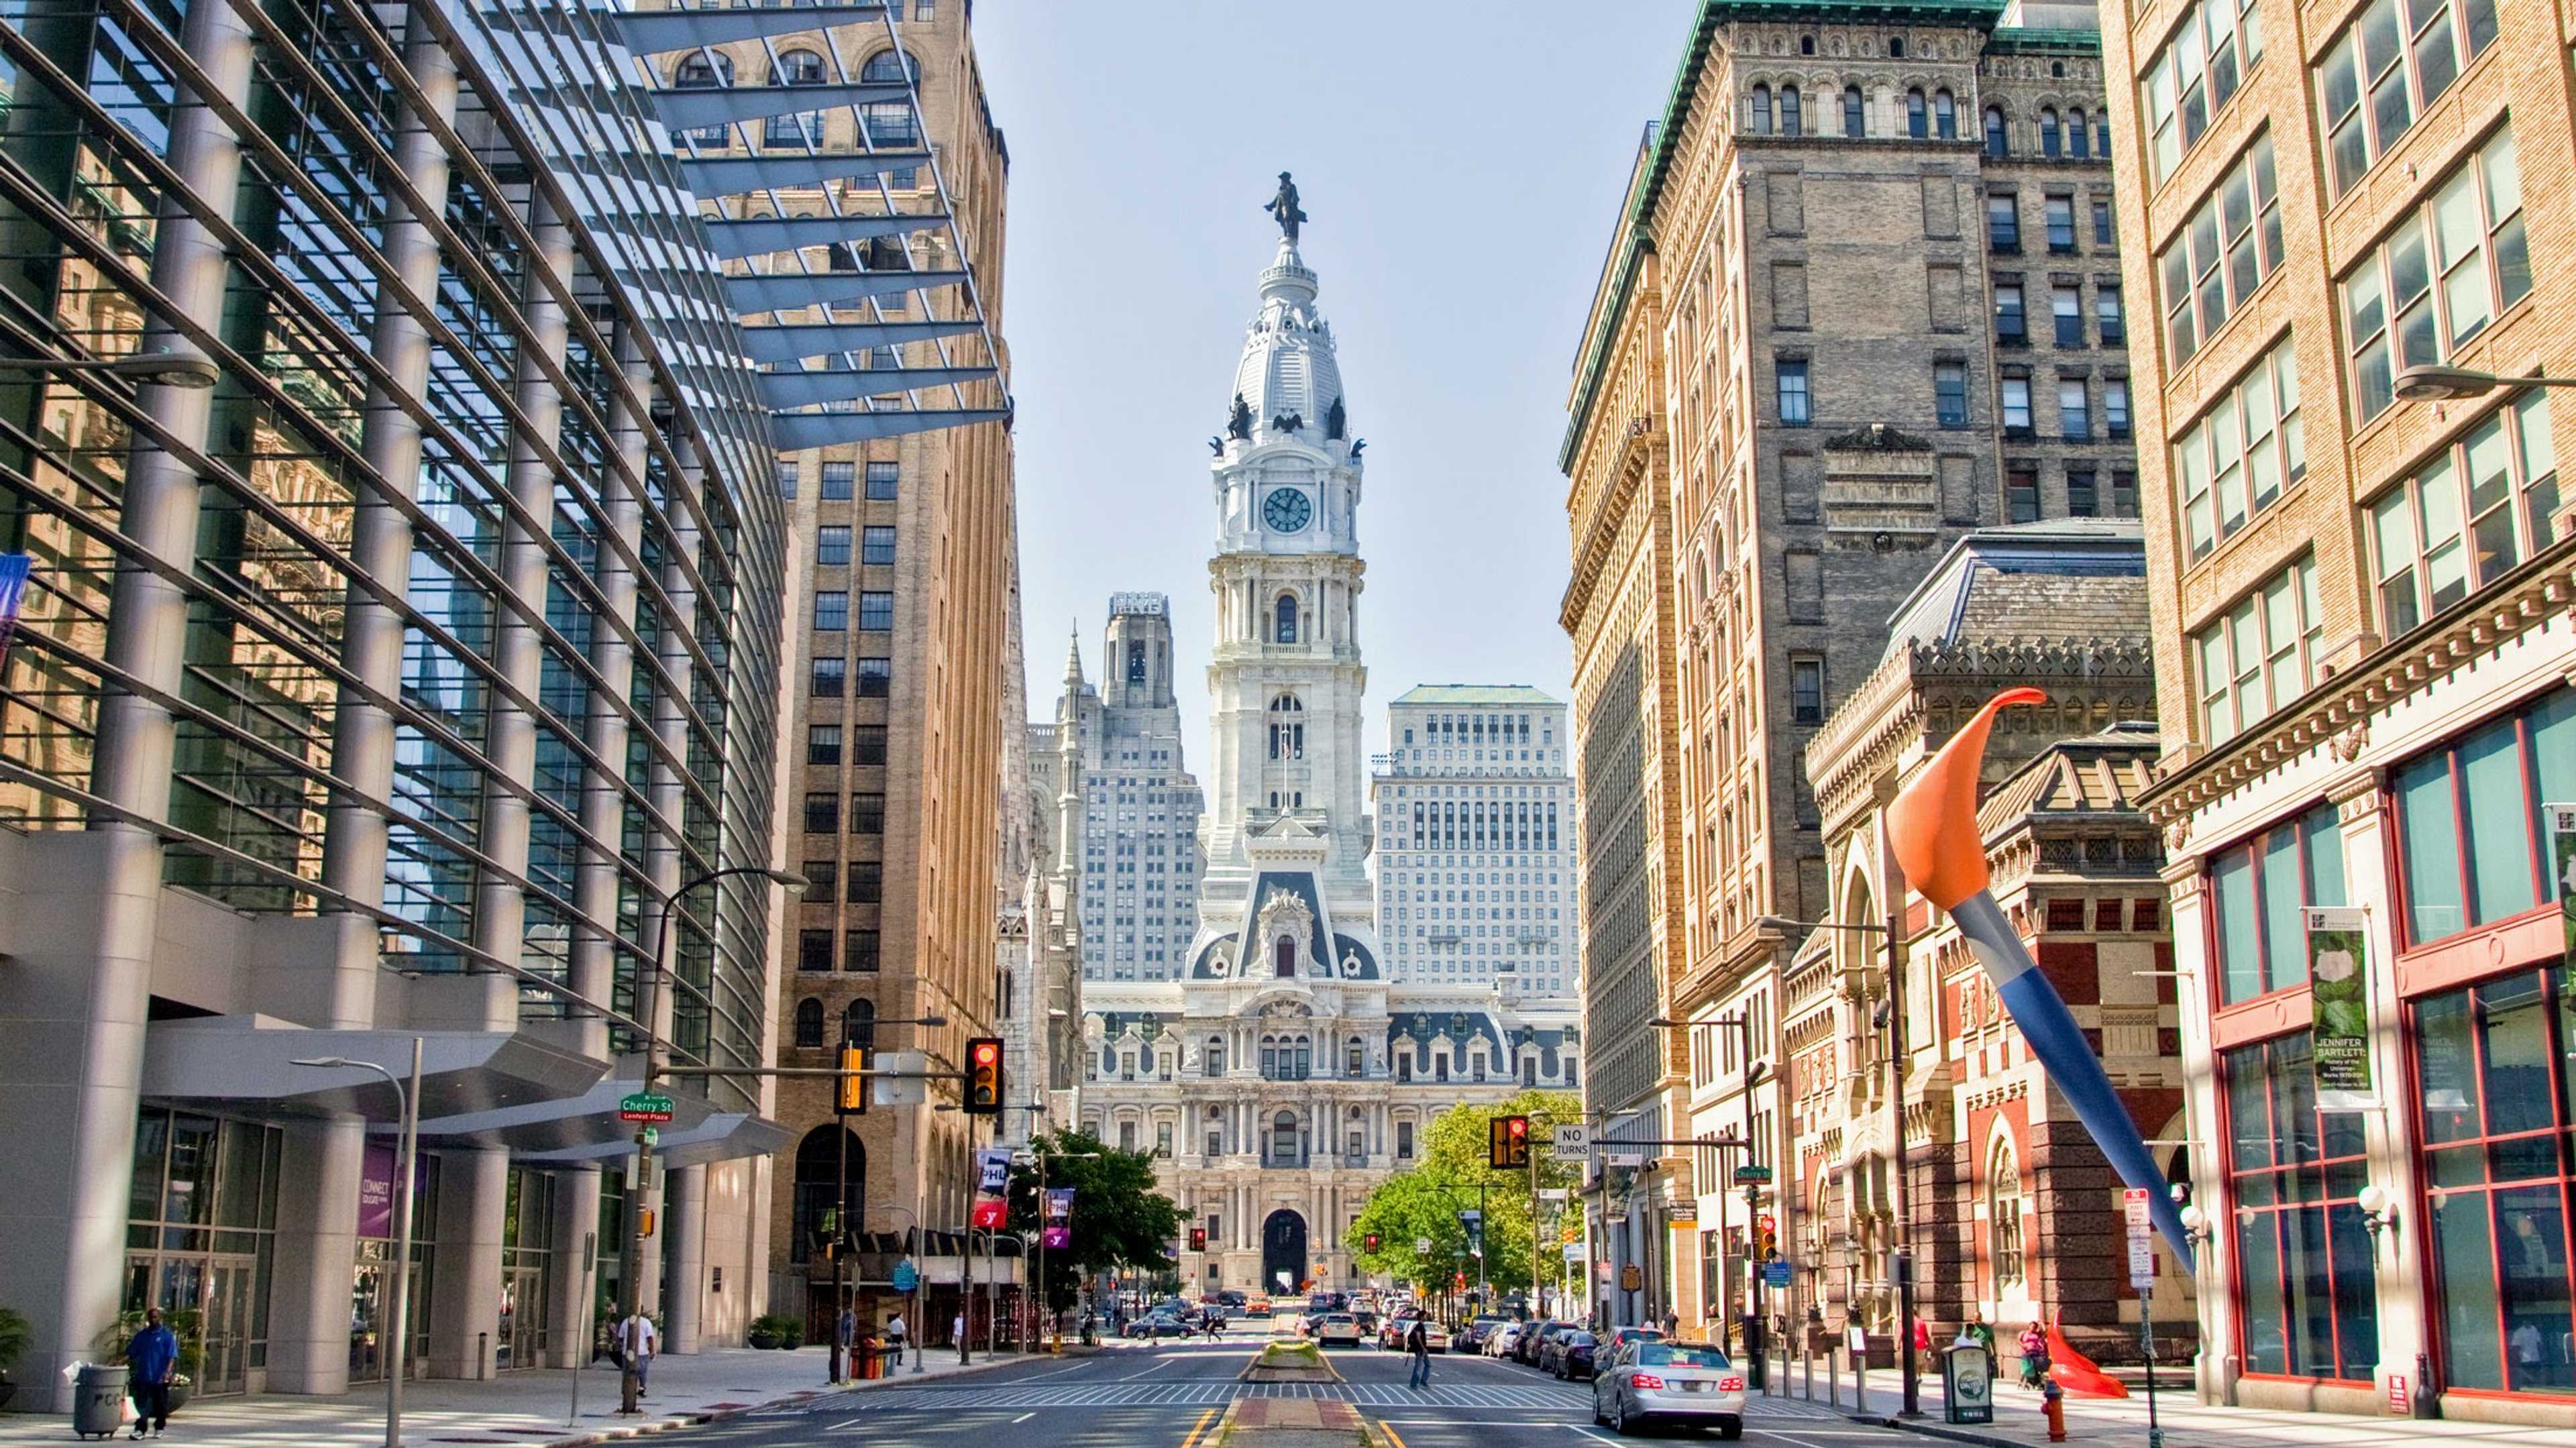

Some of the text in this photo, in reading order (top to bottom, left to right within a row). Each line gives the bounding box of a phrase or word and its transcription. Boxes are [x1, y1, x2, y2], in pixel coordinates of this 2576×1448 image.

[2318, 1038, 2361, 1046] JENNIFER
[2318, 1048, 2366, 1057] BARTLETT:
[623, 1101, 671, 1113] Cherry St
[1563, 1129, 1581, 1141] NO
[1557, 1145, 1588, 1154] TURNS
[363, 1179, 388, 1194] CONNECT
